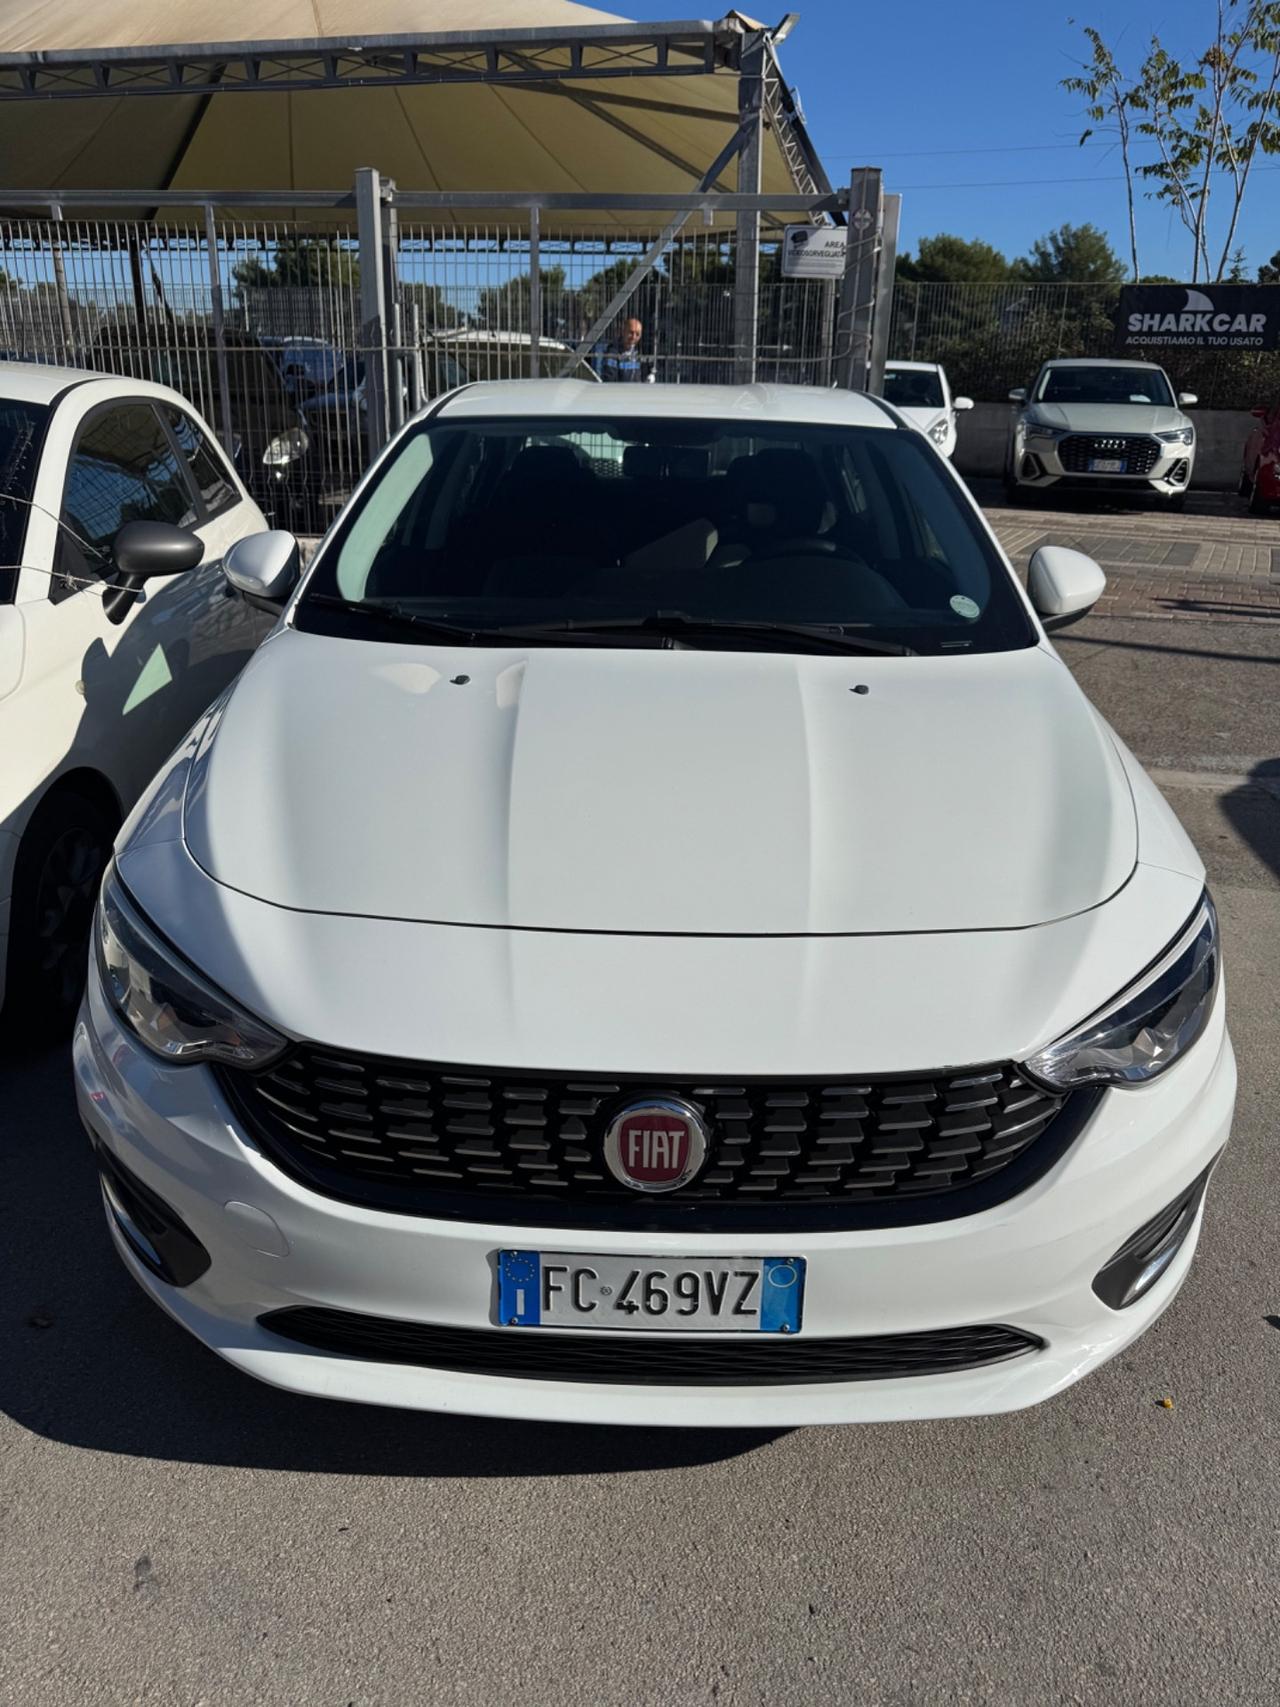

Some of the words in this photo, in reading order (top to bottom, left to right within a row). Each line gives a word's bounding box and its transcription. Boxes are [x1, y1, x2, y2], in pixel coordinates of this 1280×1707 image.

[824, 241, 845, 249] AREA
[1127, 313, 1267, 332] SHARKCAR
[1125, 336, 1195, 345] ACQUISTIAMO
[1197, 336, 1205, 345] IL
[1208, 336, 1228, 345] TUO
[1230, 336, 1264, 346] USATO
[628, 1129, 686, 1169] FIAT
[542, 1265, 598, 1312] FC
[614, 1269, 761, 1316] 469VZ
